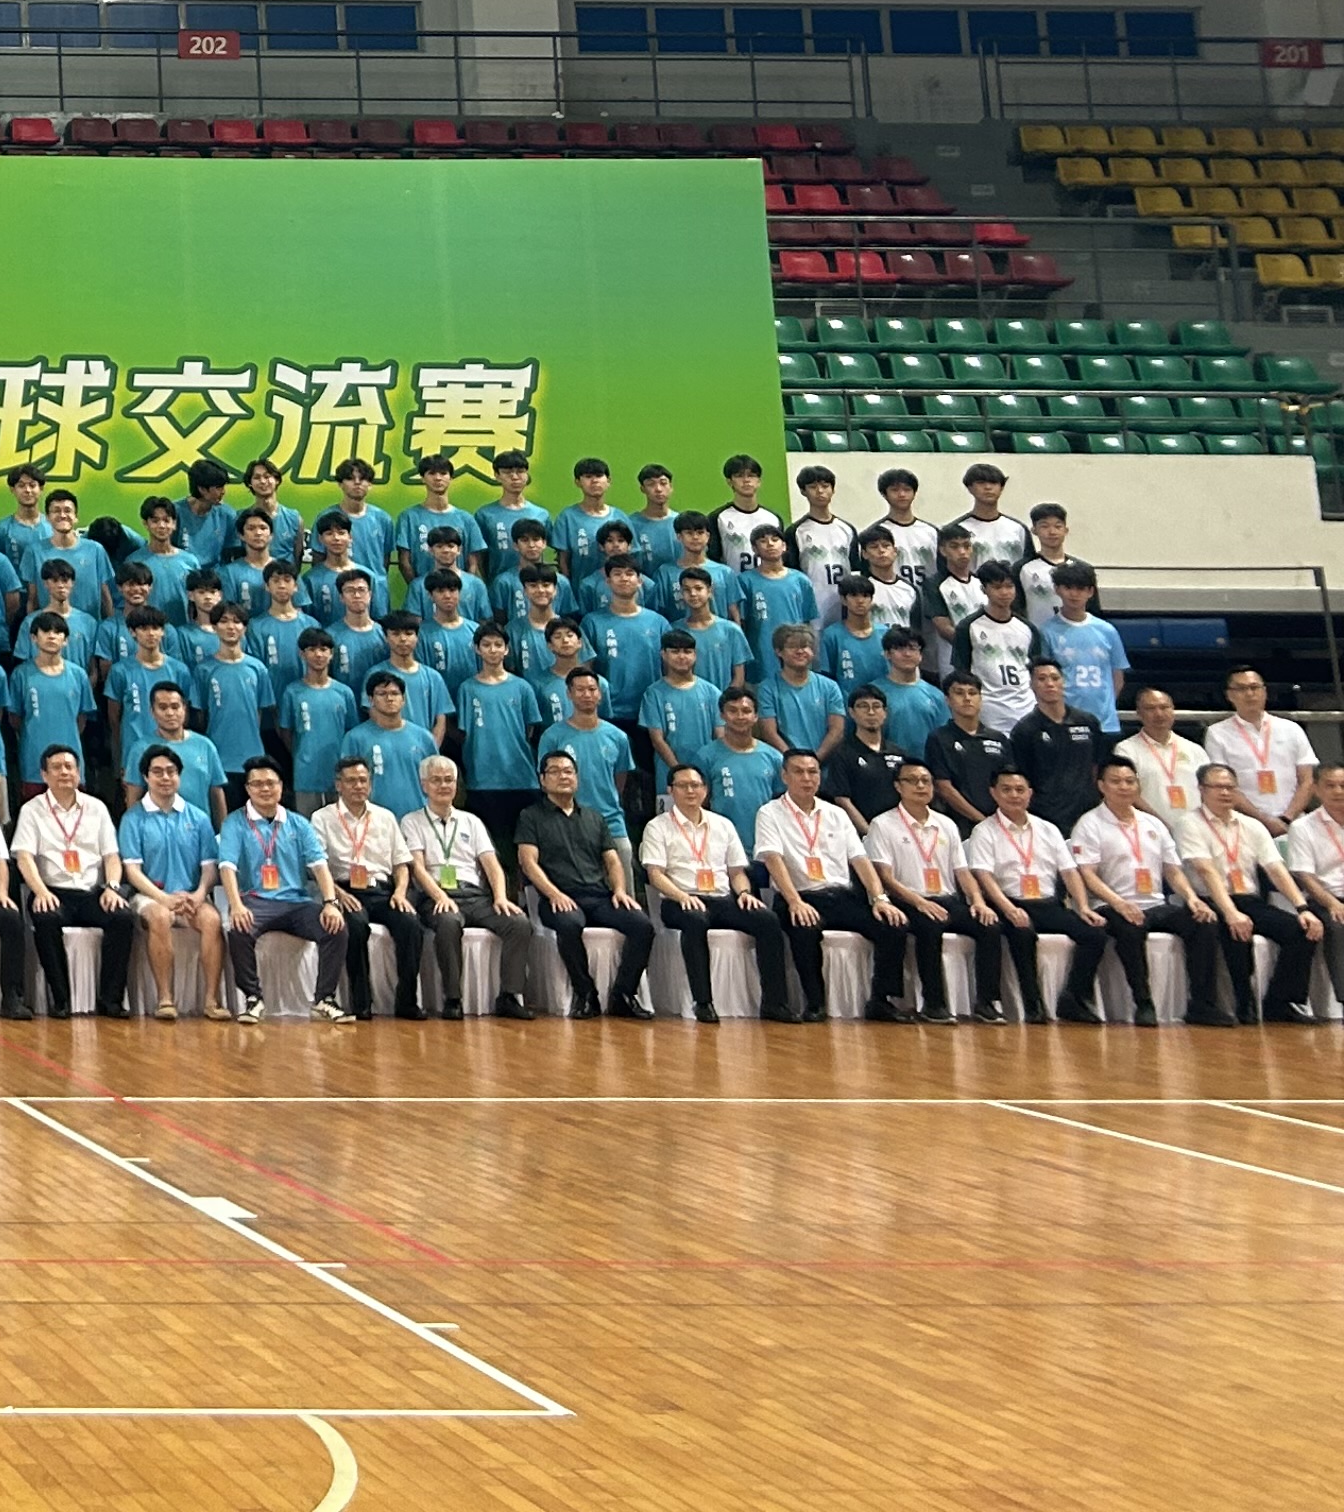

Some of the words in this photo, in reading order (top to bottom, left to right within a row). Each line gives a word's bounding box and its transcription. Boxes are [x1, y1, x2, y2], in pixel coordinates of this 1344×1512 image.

[189, 36, 227, 55] 202
[1274, 45, 1310, 63] 201
[824, 563, 843, 585] 12
[998, 664, 1021, 686] 16
[1075, 665, 1102, 687] 23
